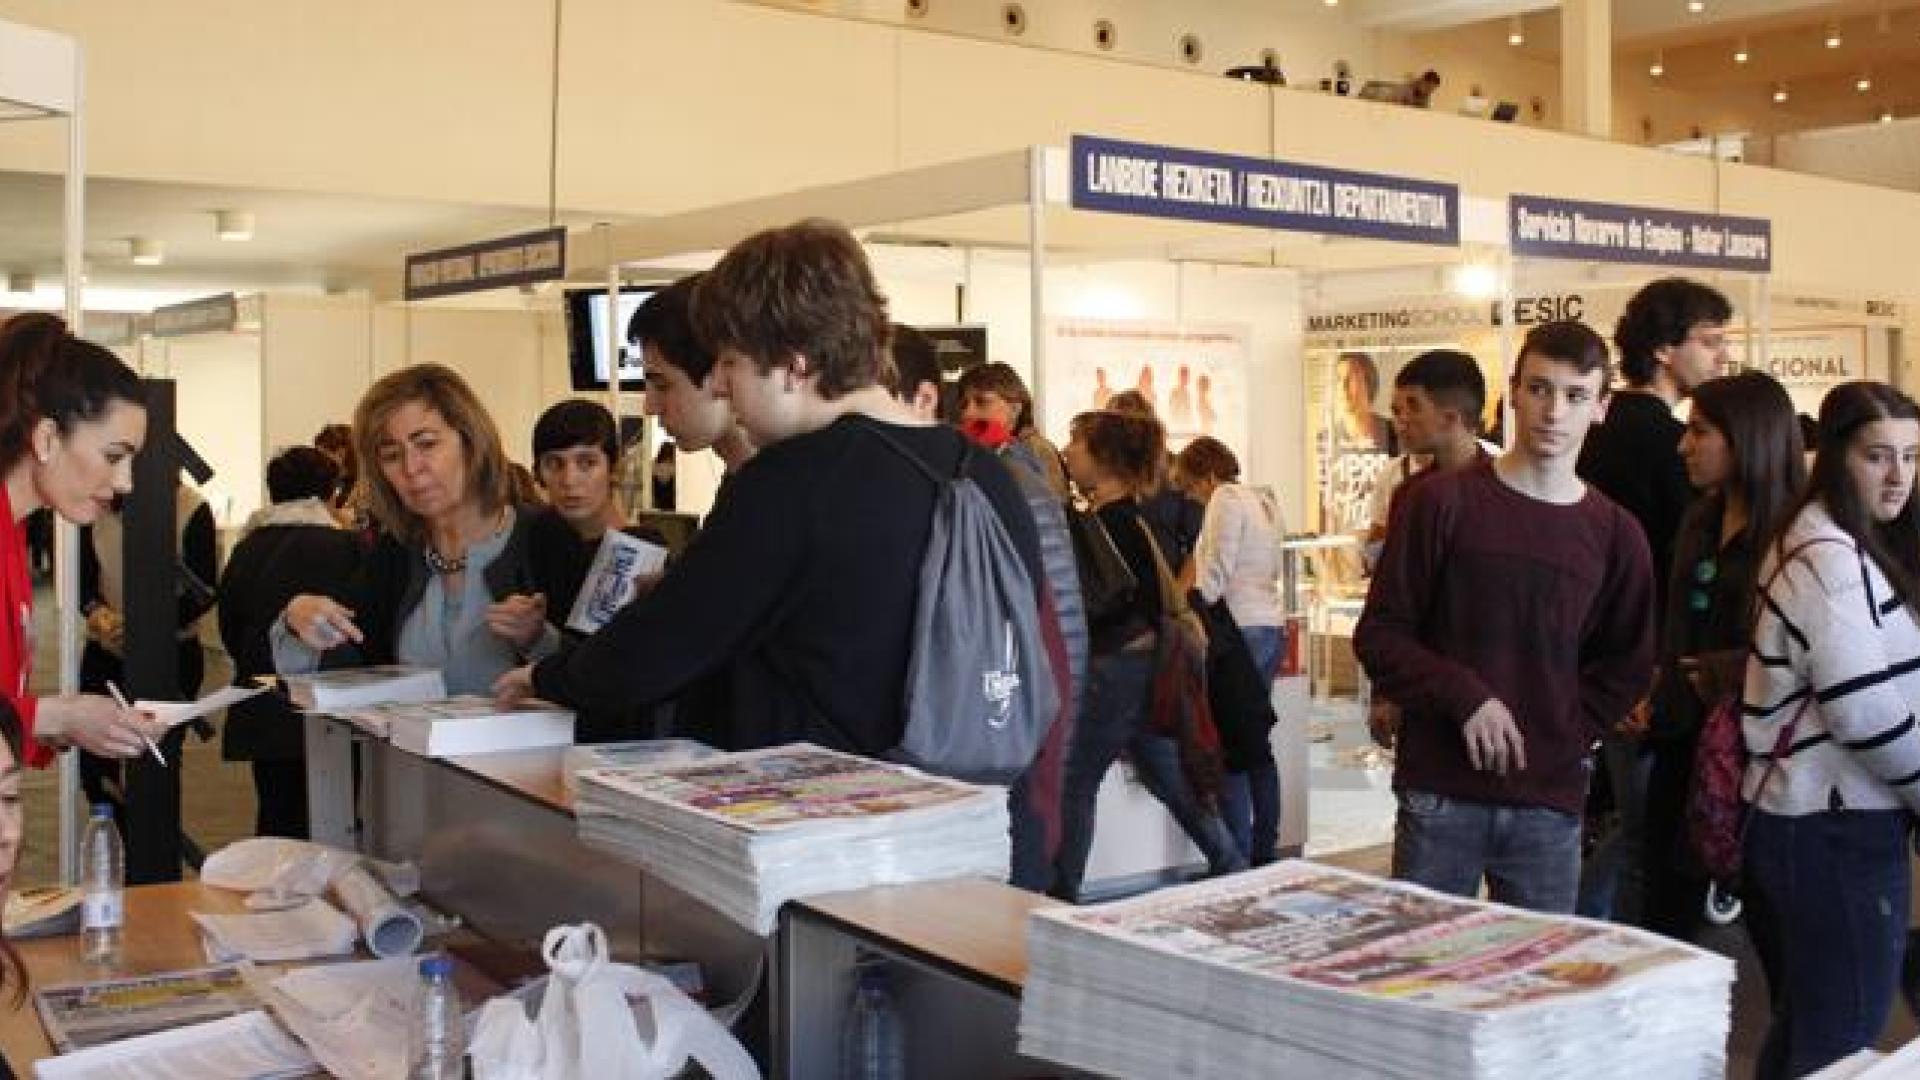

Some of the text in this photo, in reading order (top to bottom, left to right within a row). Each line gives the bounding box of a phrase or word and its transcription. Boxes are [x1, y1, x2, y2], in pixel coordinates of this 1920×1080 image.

[1087, 153, 1158, 198] LANBIDE
[1162, 161, 1233, 206] HEZIKETA
[1246, 173, 1331, 217] HEZKUNTZA
[1333, 183, 1447, 230] DEPARTAMENTUA
[1517, 207, 1570, 241] Servicio
[1574, 212, 1624, 248] Navarro
[1628, 218, 1642, 248] de
[1643, 219, 1683, 256] Empleo
[1514, 294, 1584, 325] ESIC
